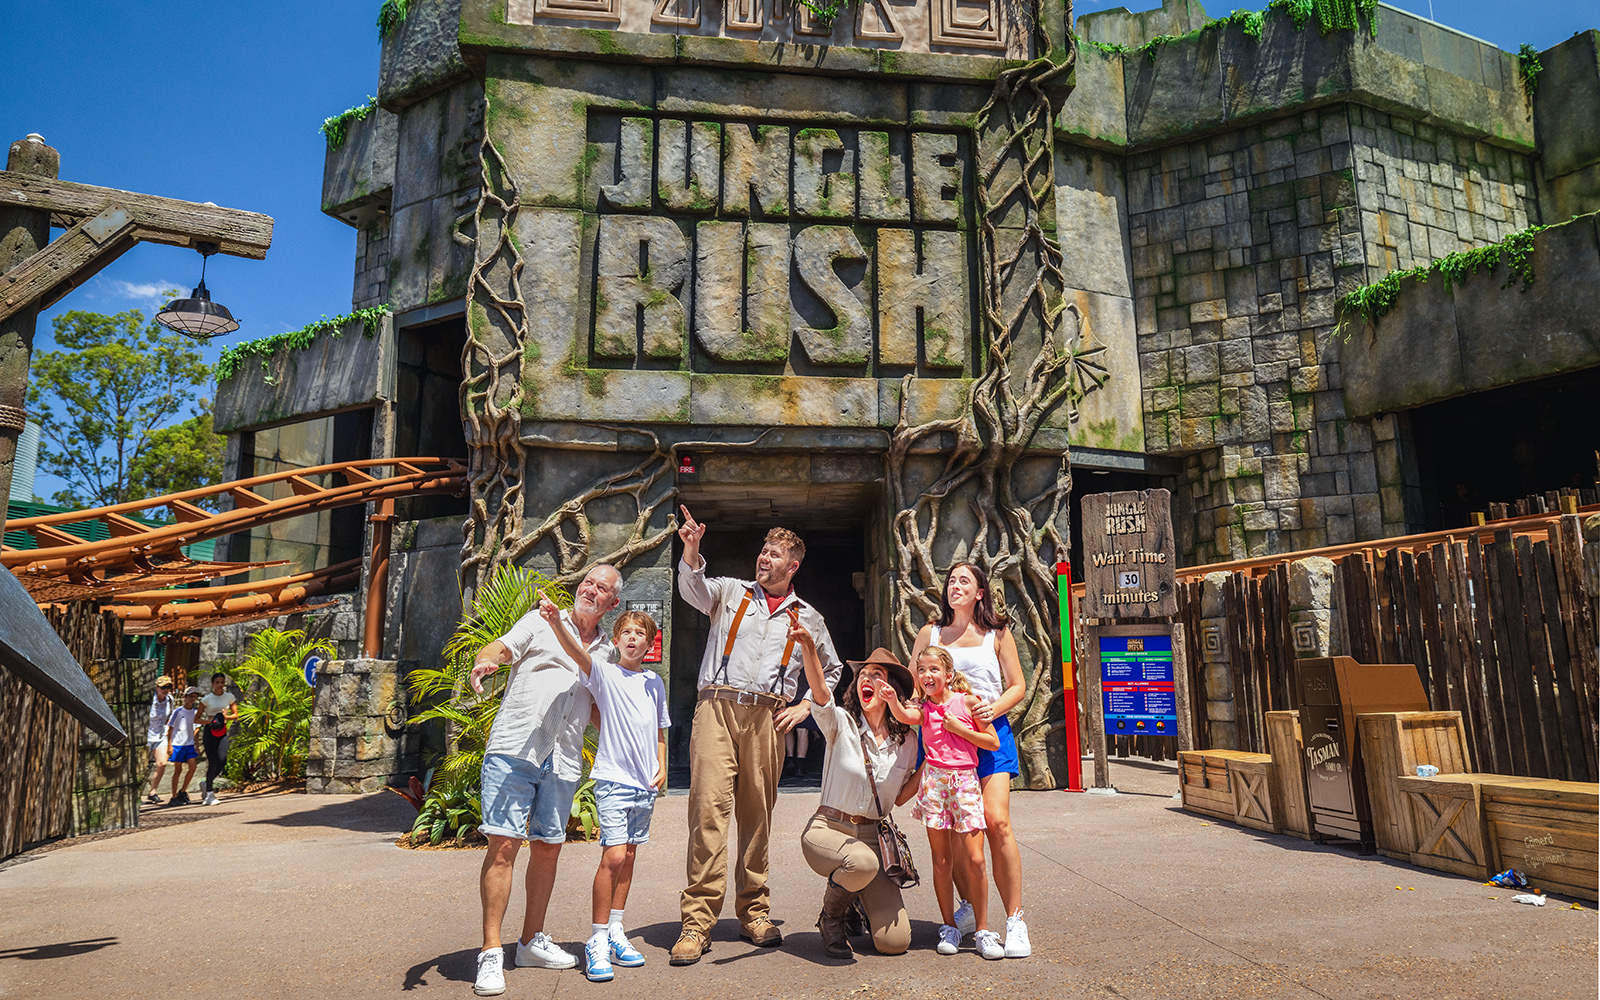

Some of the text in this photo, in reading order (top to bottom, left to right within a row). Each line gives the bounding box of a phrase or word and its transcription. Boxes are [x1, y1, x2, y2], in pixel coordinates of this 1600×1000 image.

[600, 117, 959, 223] JUNGLE
[594, 214, 965, 369] RUSH
[1105, 501, 1147, 517] JUNGLE
[1105, 514, 1147, 535] RUSH
[1092, 548, 1167, 567] Wait Time
[1125, 574, 1138, 585] 30
[1103, 590, 1159, 605] minutes
[631, 603, 658, 612] SKIP THE
[1306, 677, 1329, 691] PUSH
[1306, 742, 1340, 769] TASMAN
[1523, 851, 1566, 869] Equipment
